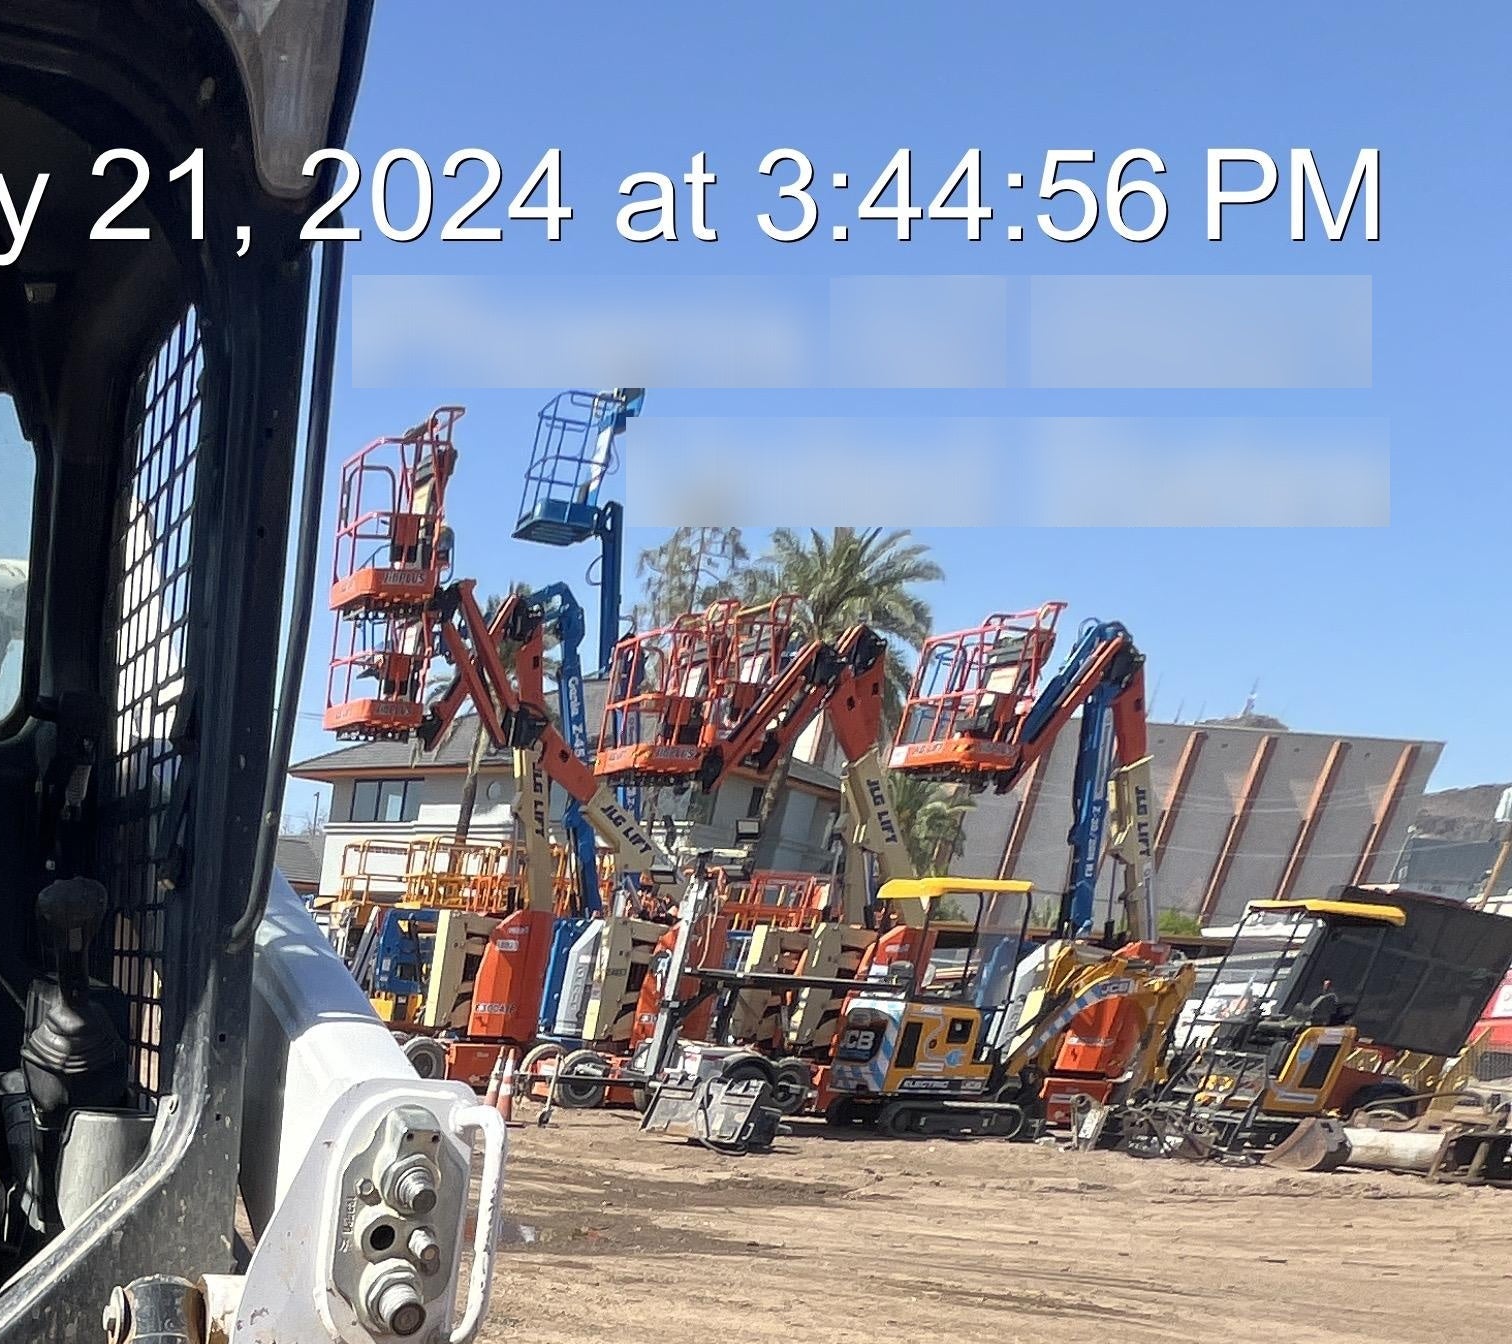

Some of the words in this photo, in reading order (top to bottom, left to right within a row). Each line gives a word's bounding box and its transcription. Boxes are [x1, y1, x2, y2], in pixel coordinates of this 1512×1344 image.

[534, 800, 546, 838] LIFT
[867, 779, 885, 806] JLG
[877, 811, 898, 843] LIFT
[1135, 786, 1149, 815] JLG
[600, 805, 626, 827] JLG
[622, 827, 652, 854] LIFT
[1138, 823, 1151, 857] LIFT
